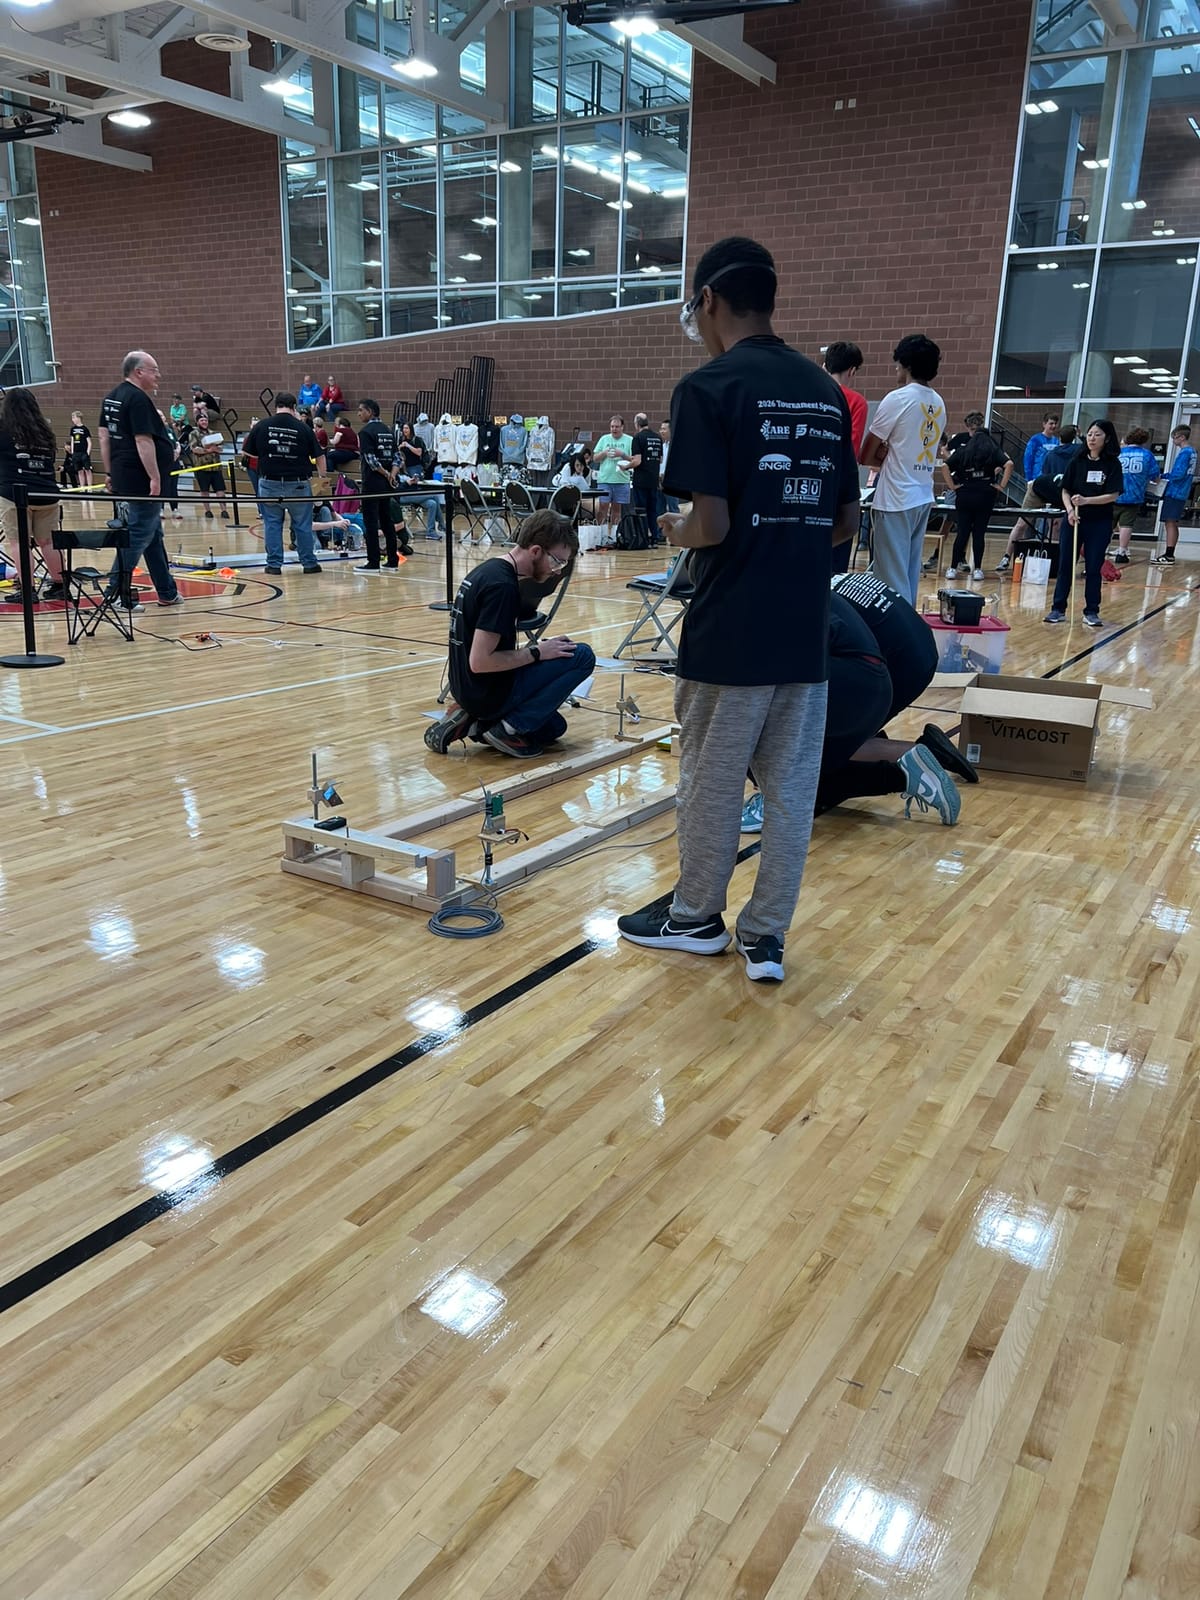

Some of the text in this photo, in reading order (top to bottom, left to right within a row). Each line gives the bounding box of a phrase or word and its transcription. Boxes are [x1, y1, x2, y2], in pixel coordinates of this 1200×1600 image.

[757, 400, 776, 408] 2026
[776, 400, 818, 409] Tournament
[1118, 456, 1143, 474] 26
[991, 721, 1070, 744] VITACOST
